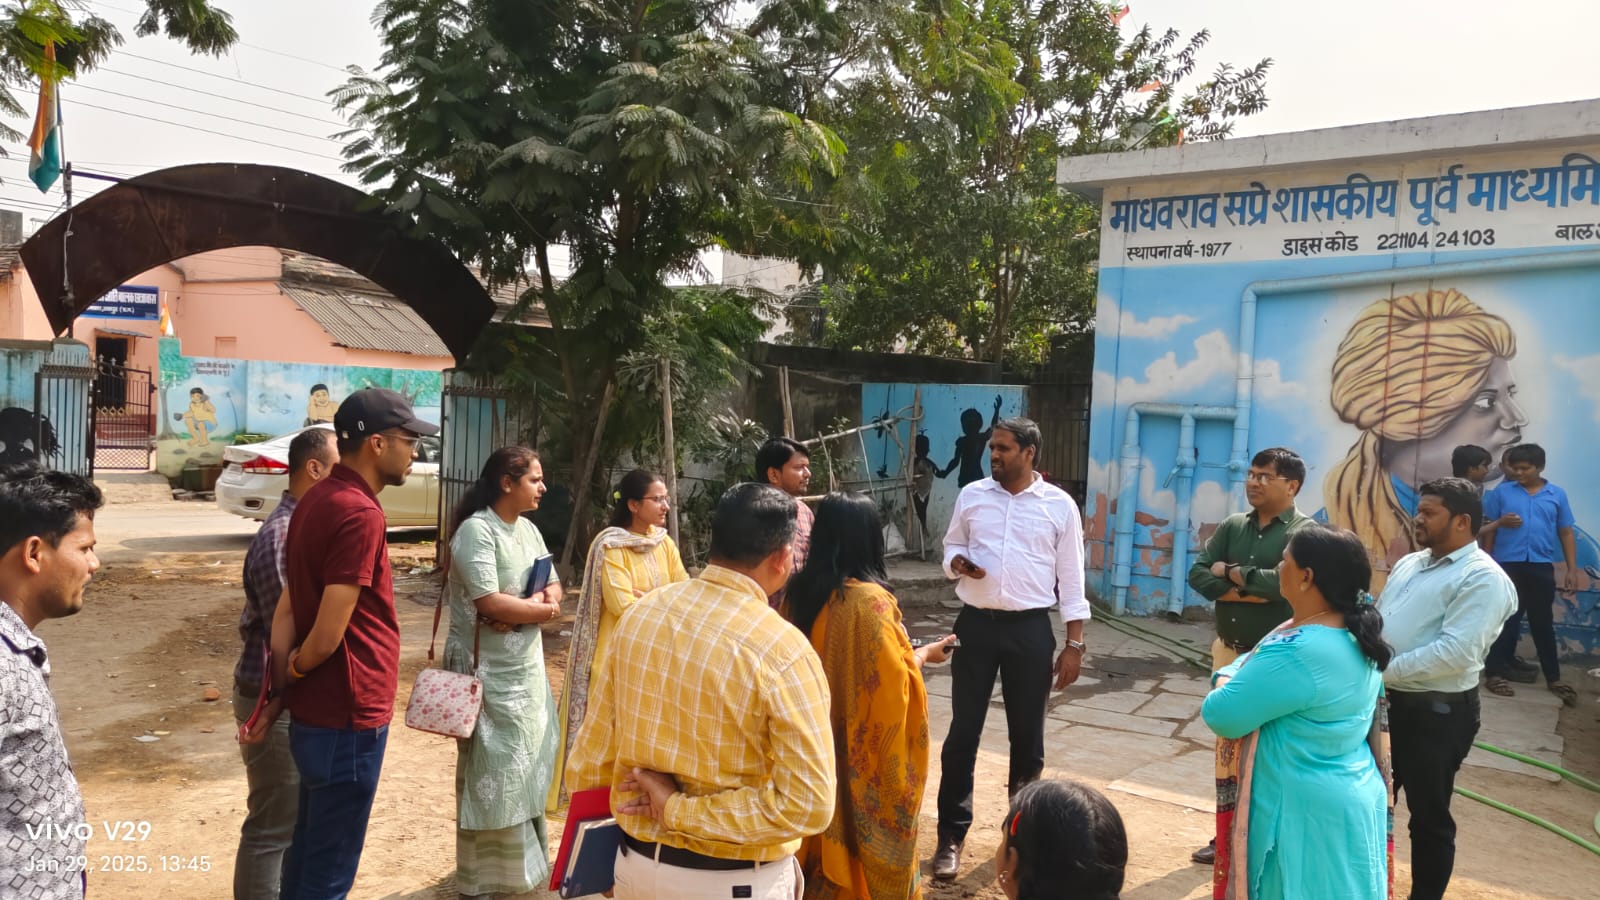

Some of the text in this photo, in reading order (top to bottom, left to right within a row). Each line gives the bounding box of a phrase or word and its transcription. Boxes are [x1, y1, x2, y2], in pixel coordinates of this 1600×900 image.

[1109, 192, 1220, 233] माधवराव
[1223, 181, 1271, 227] सप्रे
[1272, 173, 1399, 223] शासकीय
[1407, 164, 1464, 226] पूर्व
[1325, 231, 1358, 251] कोड
[1127, 245, 1173, 261] स्थापना
